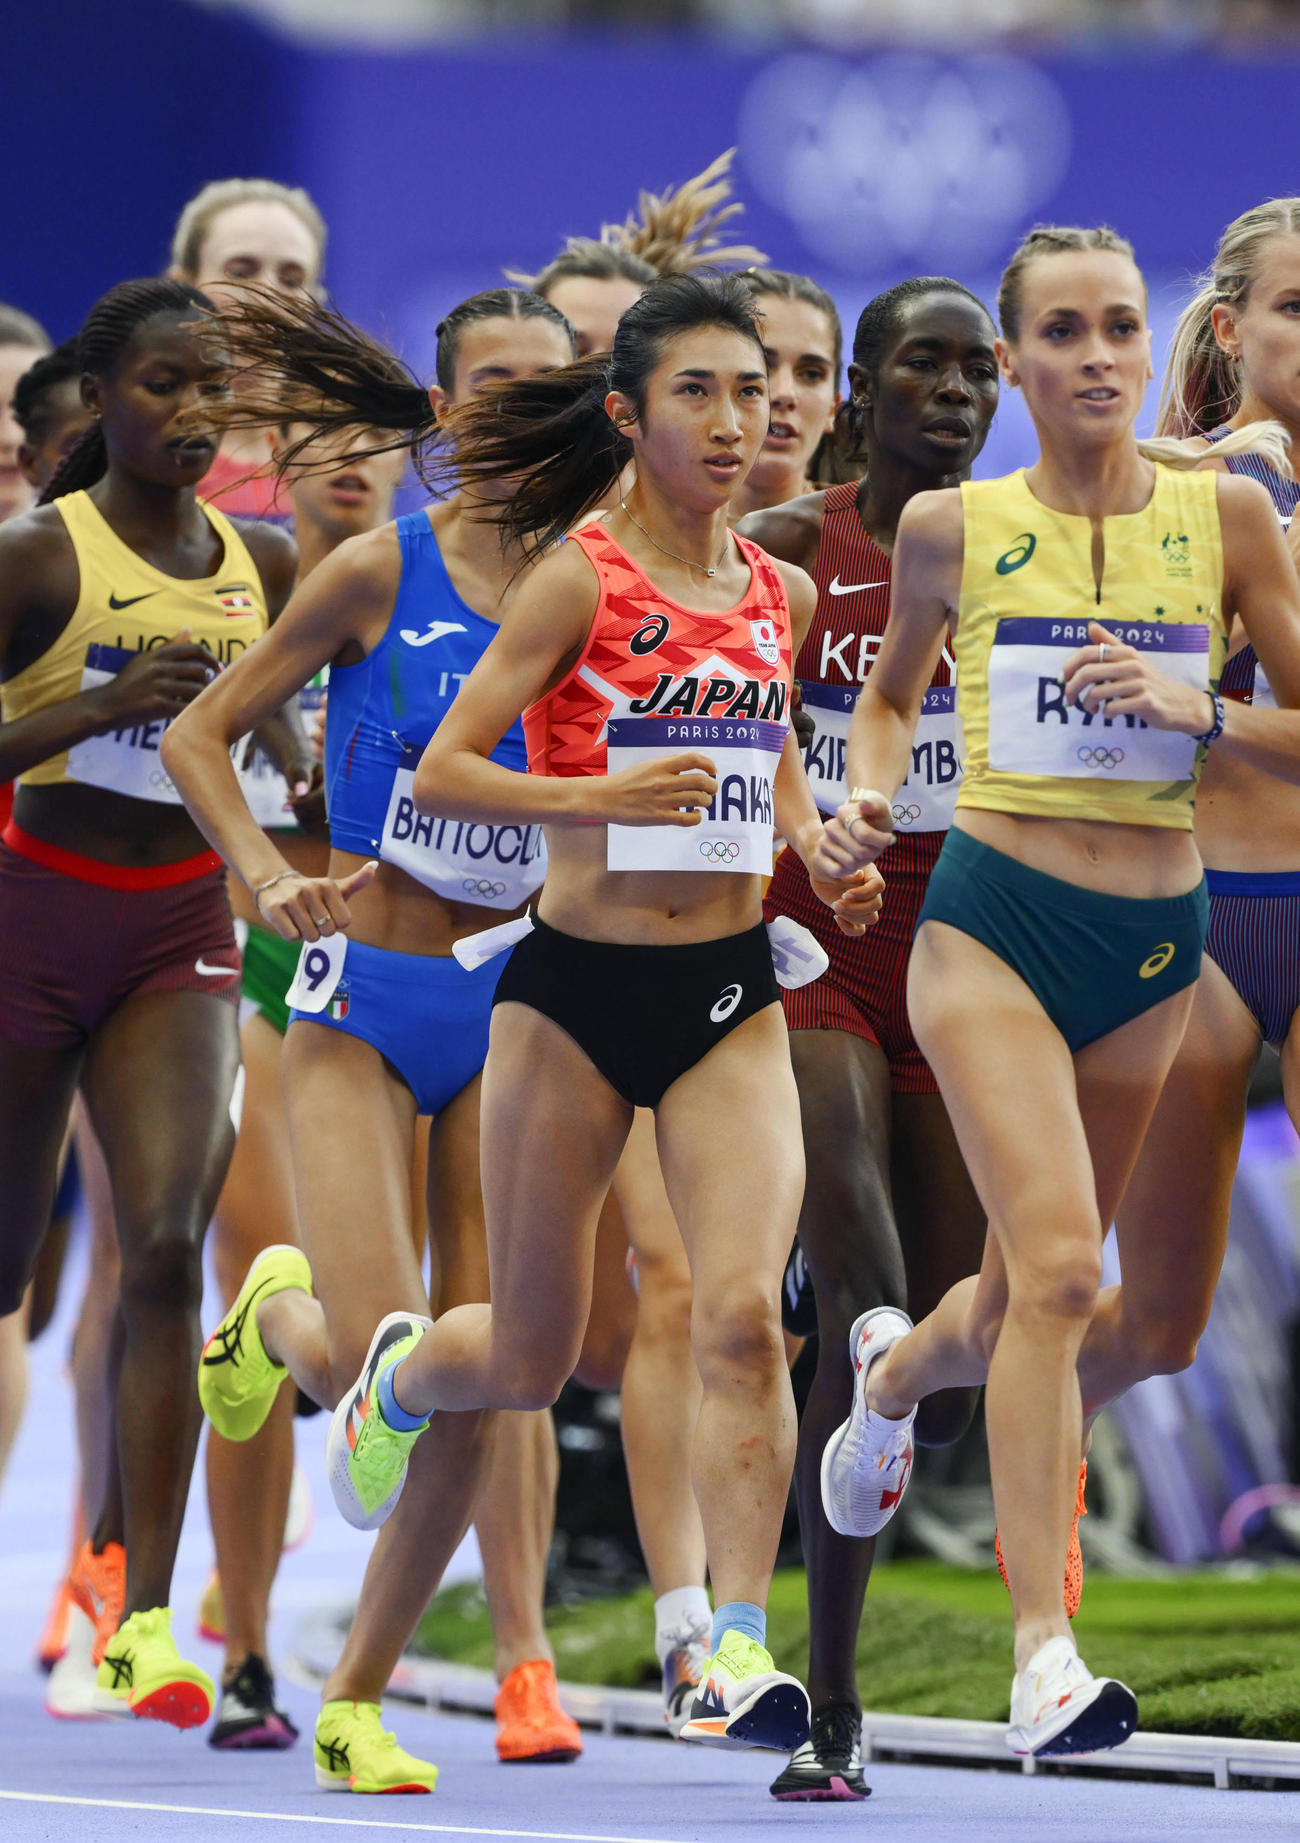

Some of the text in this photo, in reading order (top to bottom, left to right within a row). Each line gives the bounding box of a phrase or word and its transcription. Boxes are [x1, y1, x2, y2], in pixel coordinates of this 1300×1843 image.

[1115, 627, 1165, 644] 2024
[629, 674, 786, 722] JAPAN
[726, 726, 760, 740] 2024
[304, 947, 331, 992] 9
